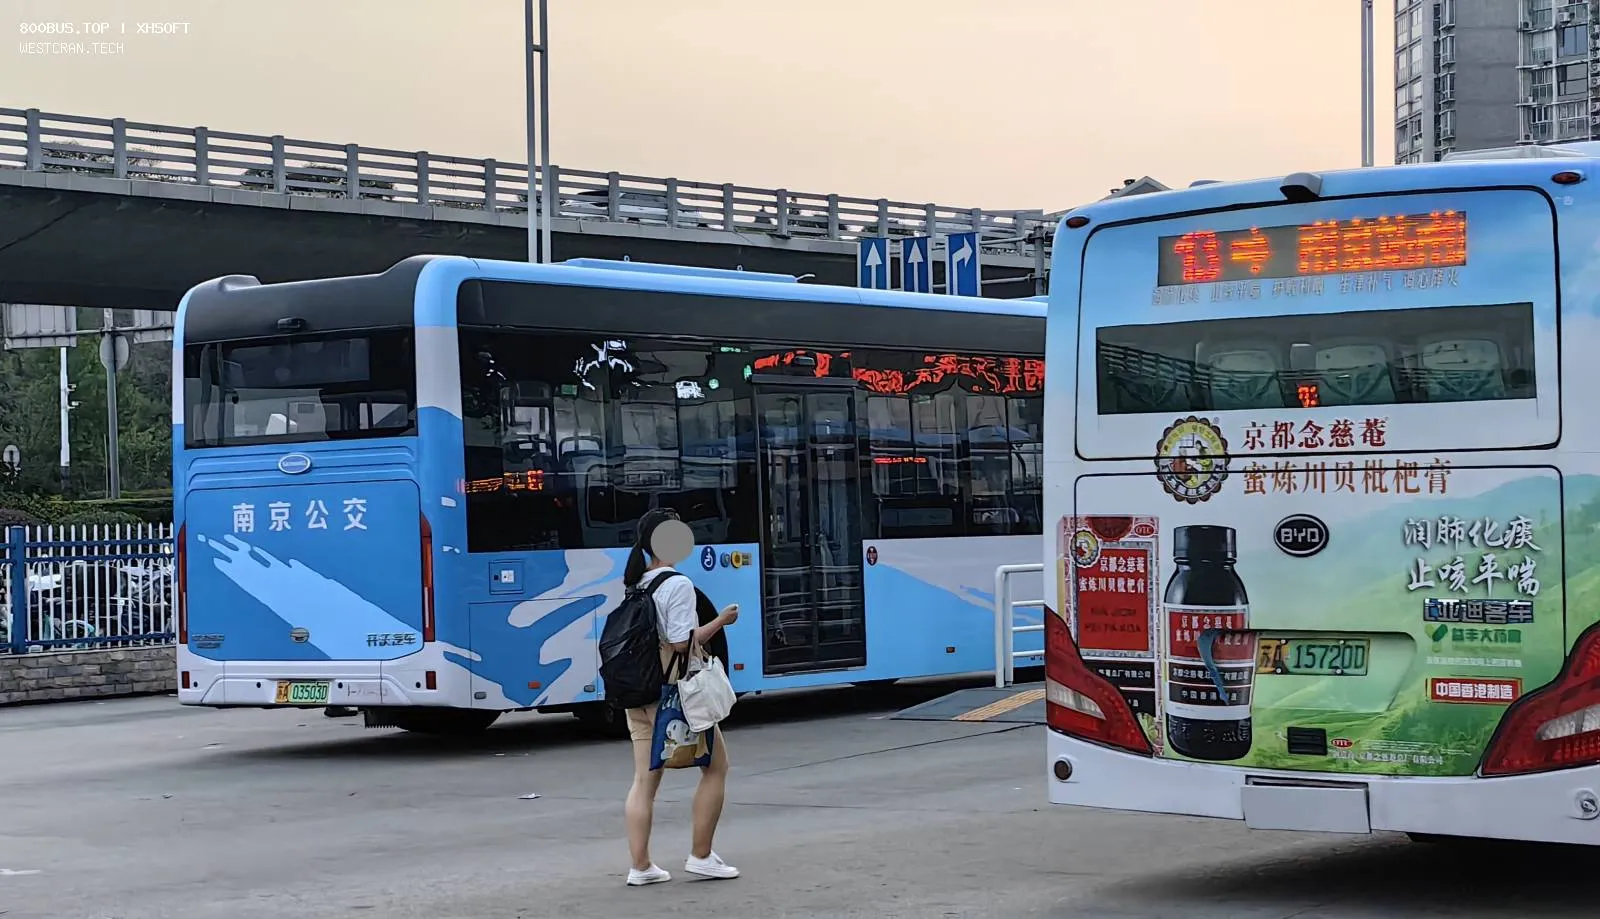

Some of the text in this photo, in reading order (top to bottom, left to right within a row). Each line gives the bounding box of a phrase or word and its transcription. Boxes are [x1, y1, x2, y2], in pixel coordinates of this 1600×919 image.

[1241, 417, 1387, 450] 京都念慈菴
[1243, 457, 1453, 495] 蜜炼川贝枇杷膏
[232, 497, 367, 533] 南京公交
[1403, 514, 1542, 551] 润肺化痰
[1280, 527, 1320, 543] BYD
[1407, 553, 1540, 597] 止咳平喘
[1435, 682, 1513, 700] 中国香港制造
